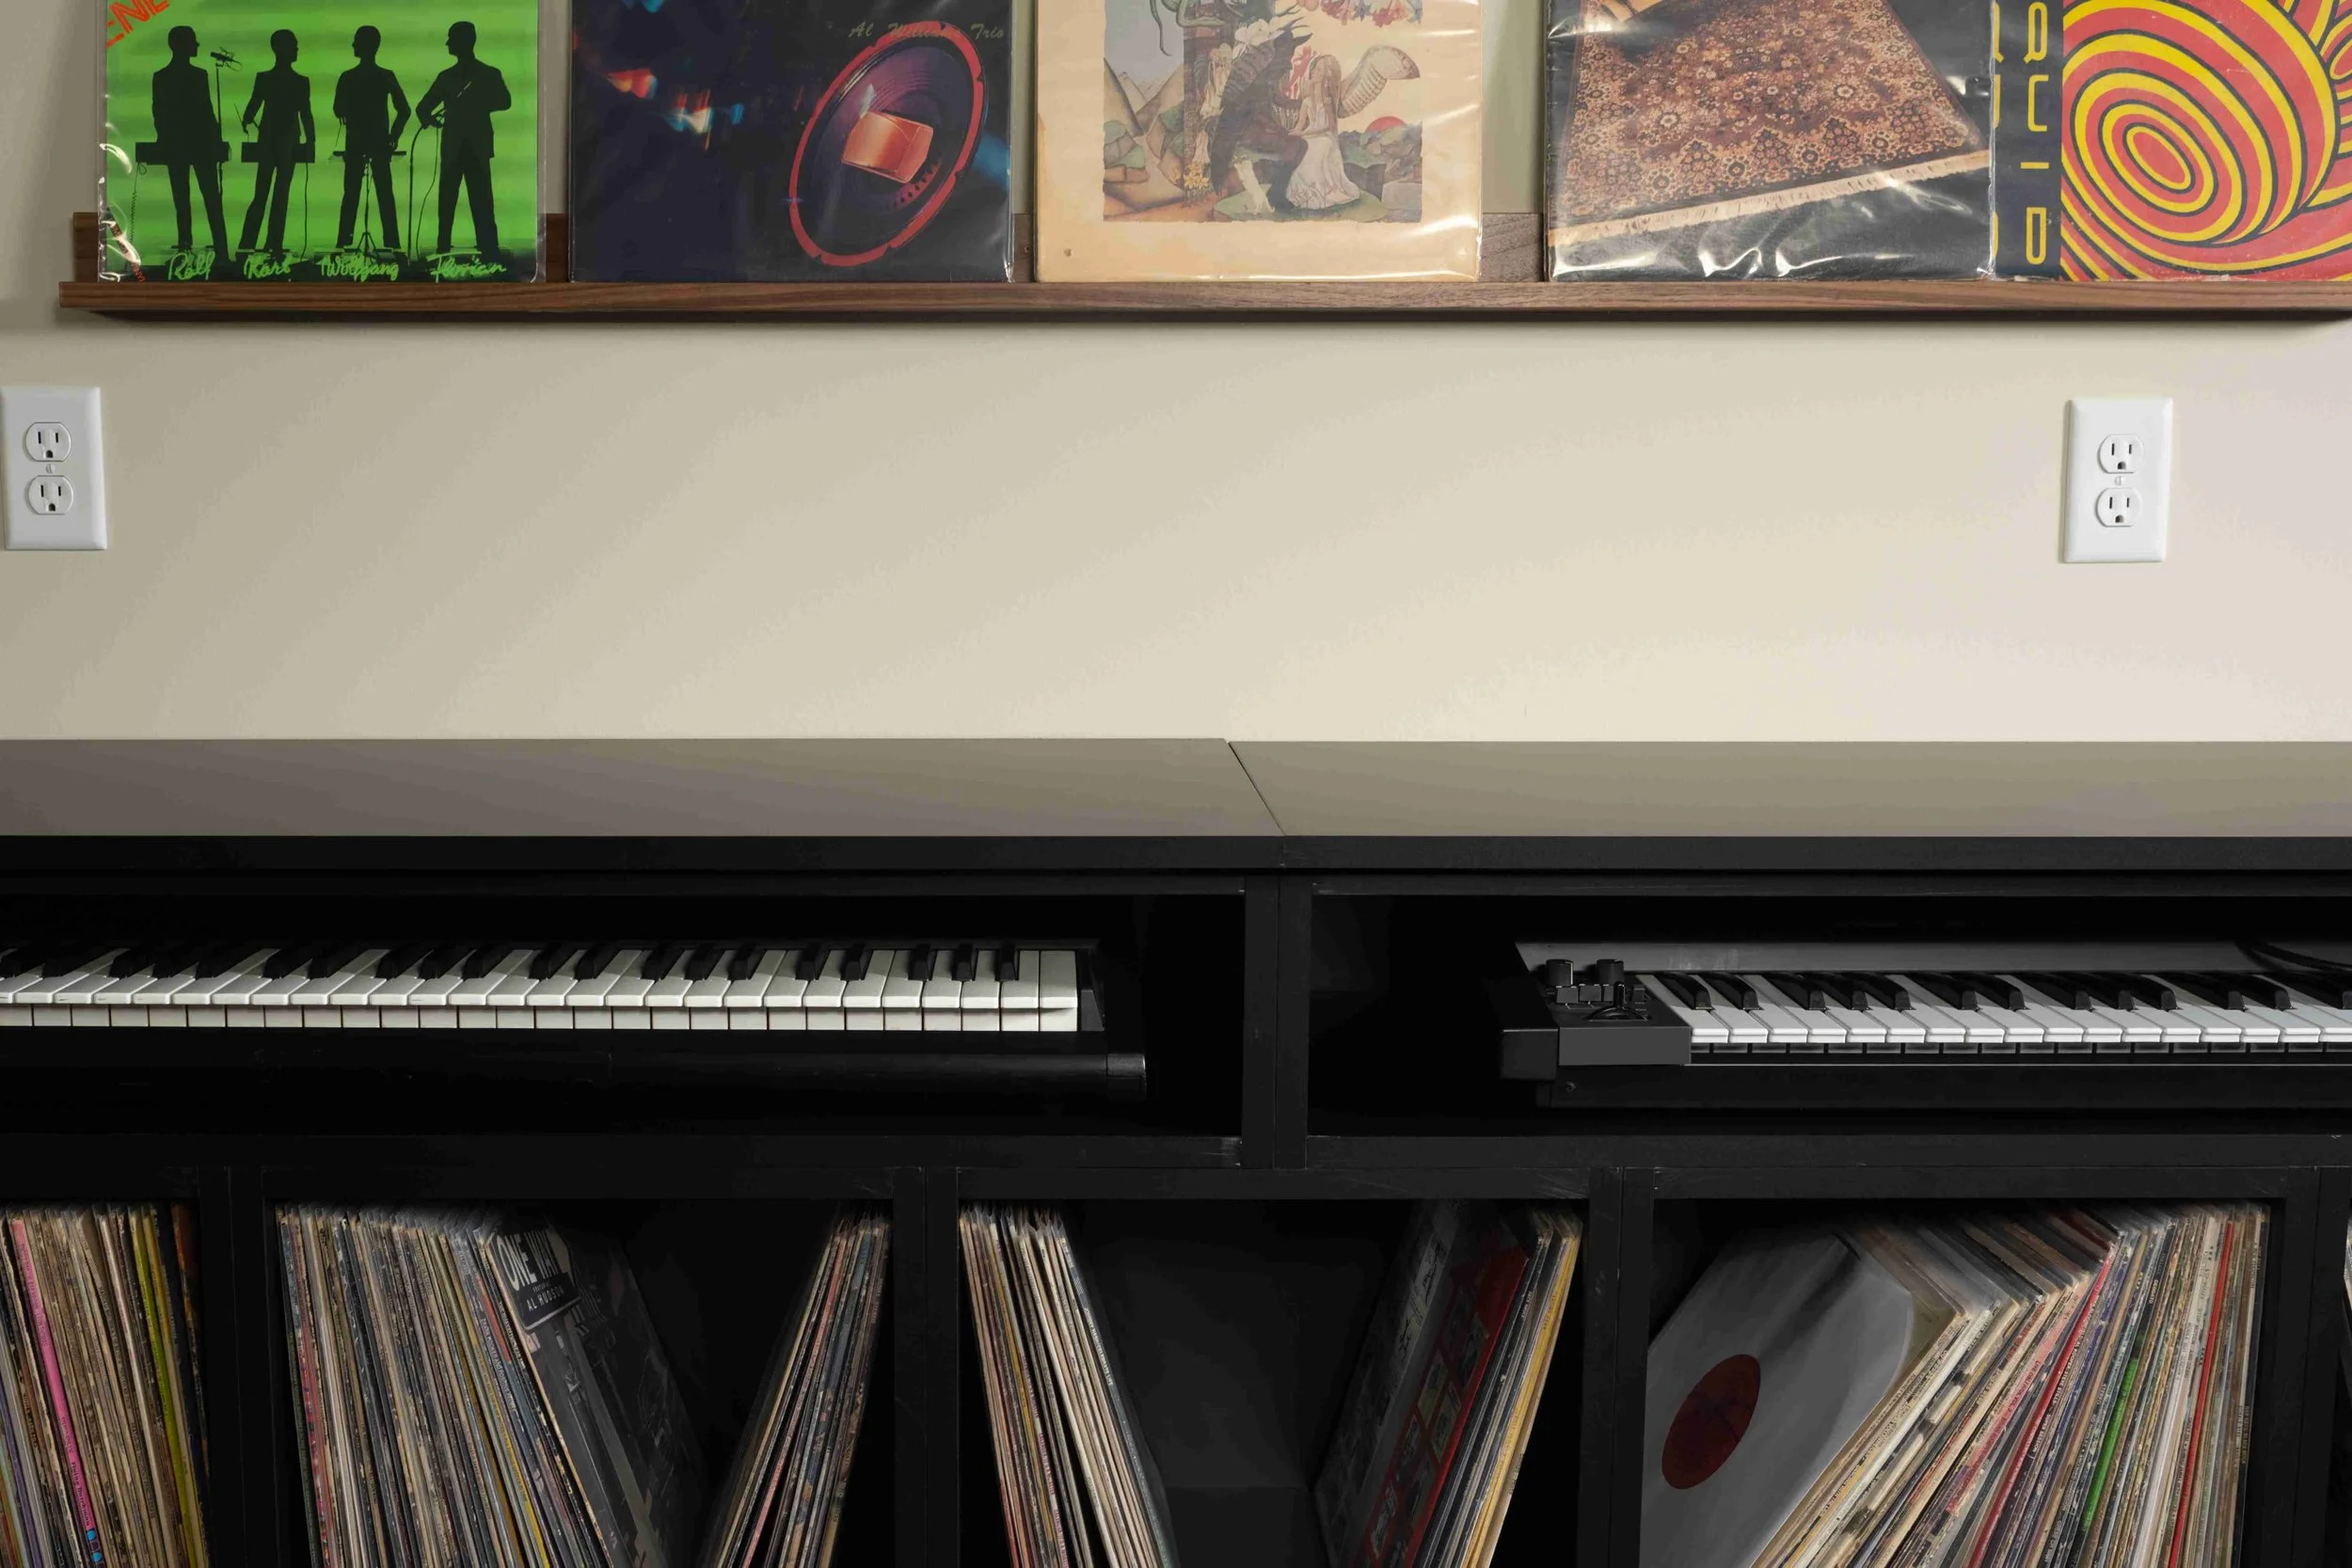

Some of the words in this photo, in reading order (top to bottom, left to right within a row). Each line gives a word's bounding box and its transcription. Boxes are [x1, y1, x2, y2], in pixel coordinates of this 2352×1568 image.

[848, 21, 874, 38] Al
[970, 23, 1005, 40] Trio
[167, 251, 215, 281] Ralf
[321, 252, 399, 281] Wolfgang
[496, 1233, 538, 1291] ONE
[526, 1297, 538, 1313] AL
